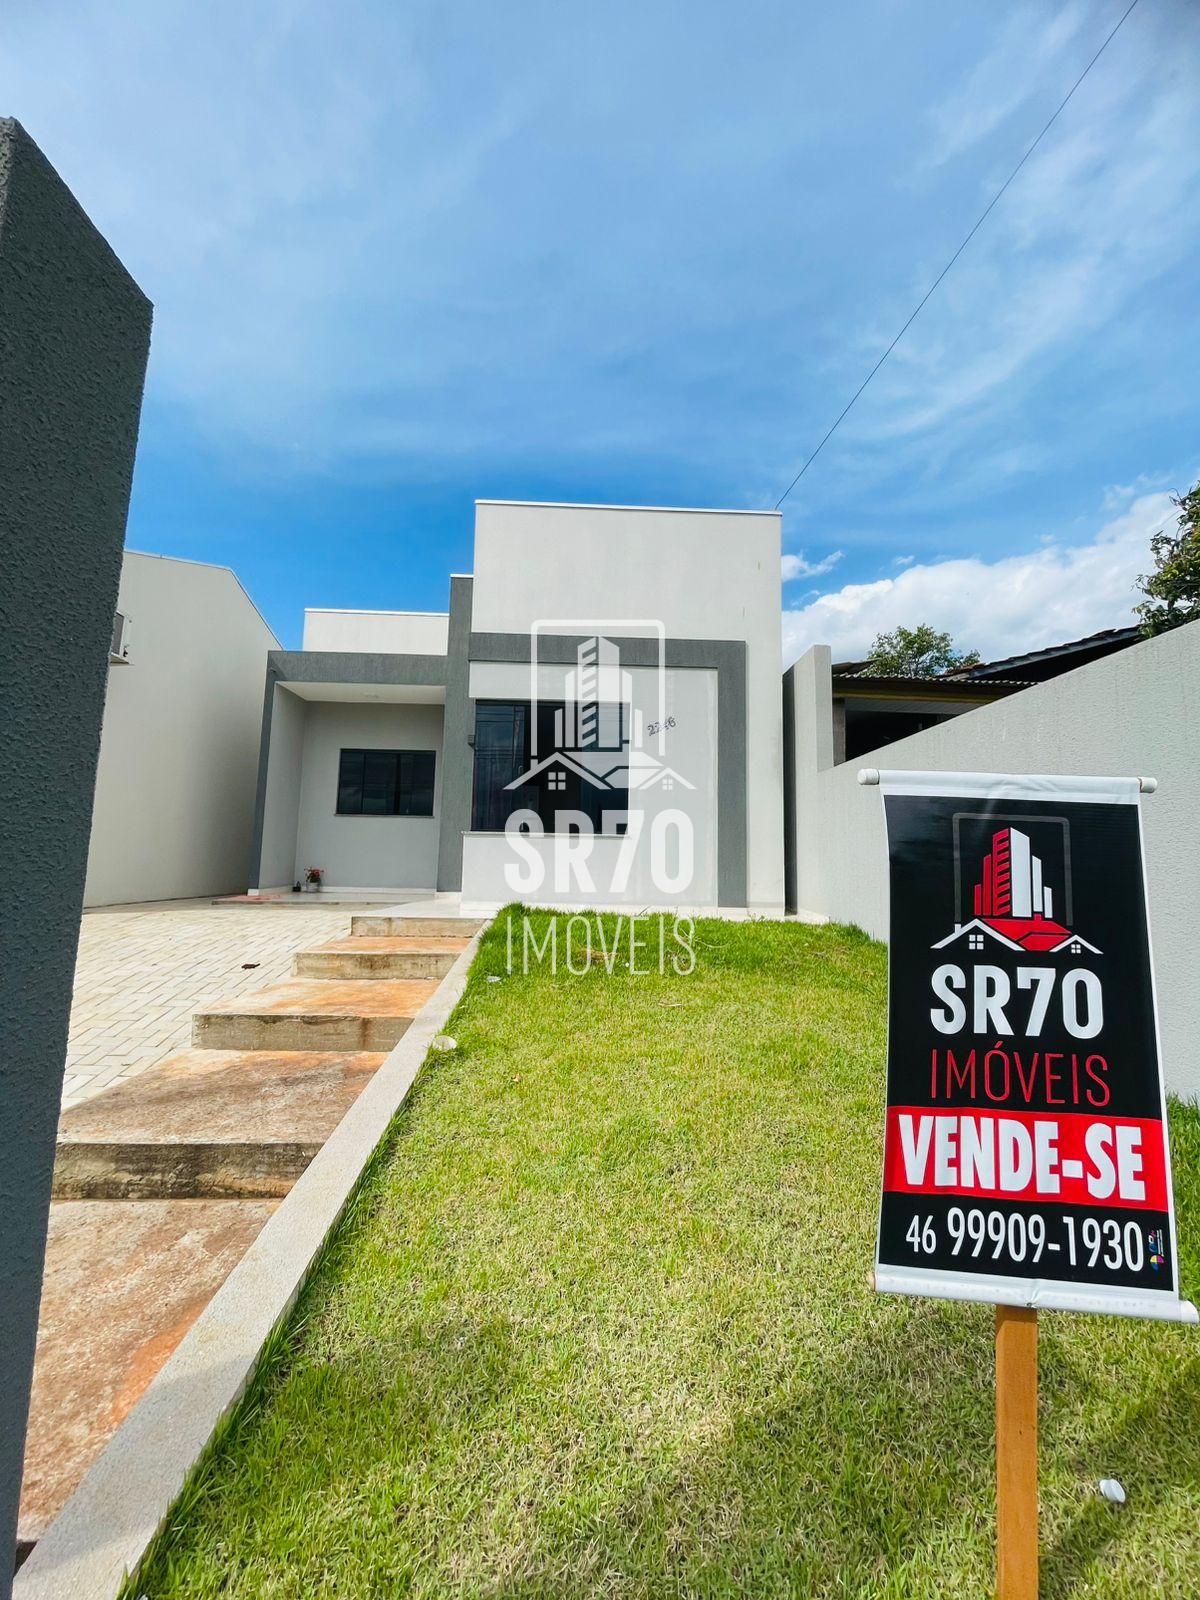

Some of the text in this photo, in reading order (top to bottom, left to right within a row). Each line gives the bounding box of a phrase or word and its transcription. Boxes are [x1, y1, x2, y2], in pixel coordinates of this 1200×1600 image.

[930, 963, 1104, 1039] SR70
[931, 1040, 1111, 1107] IMÓVEIS
[898, 1114, 1146, 1200] VENDE-SE
[905, 1214, 937, 1254] 46
[947, 1206, 1144, 1272] 99909-1930
